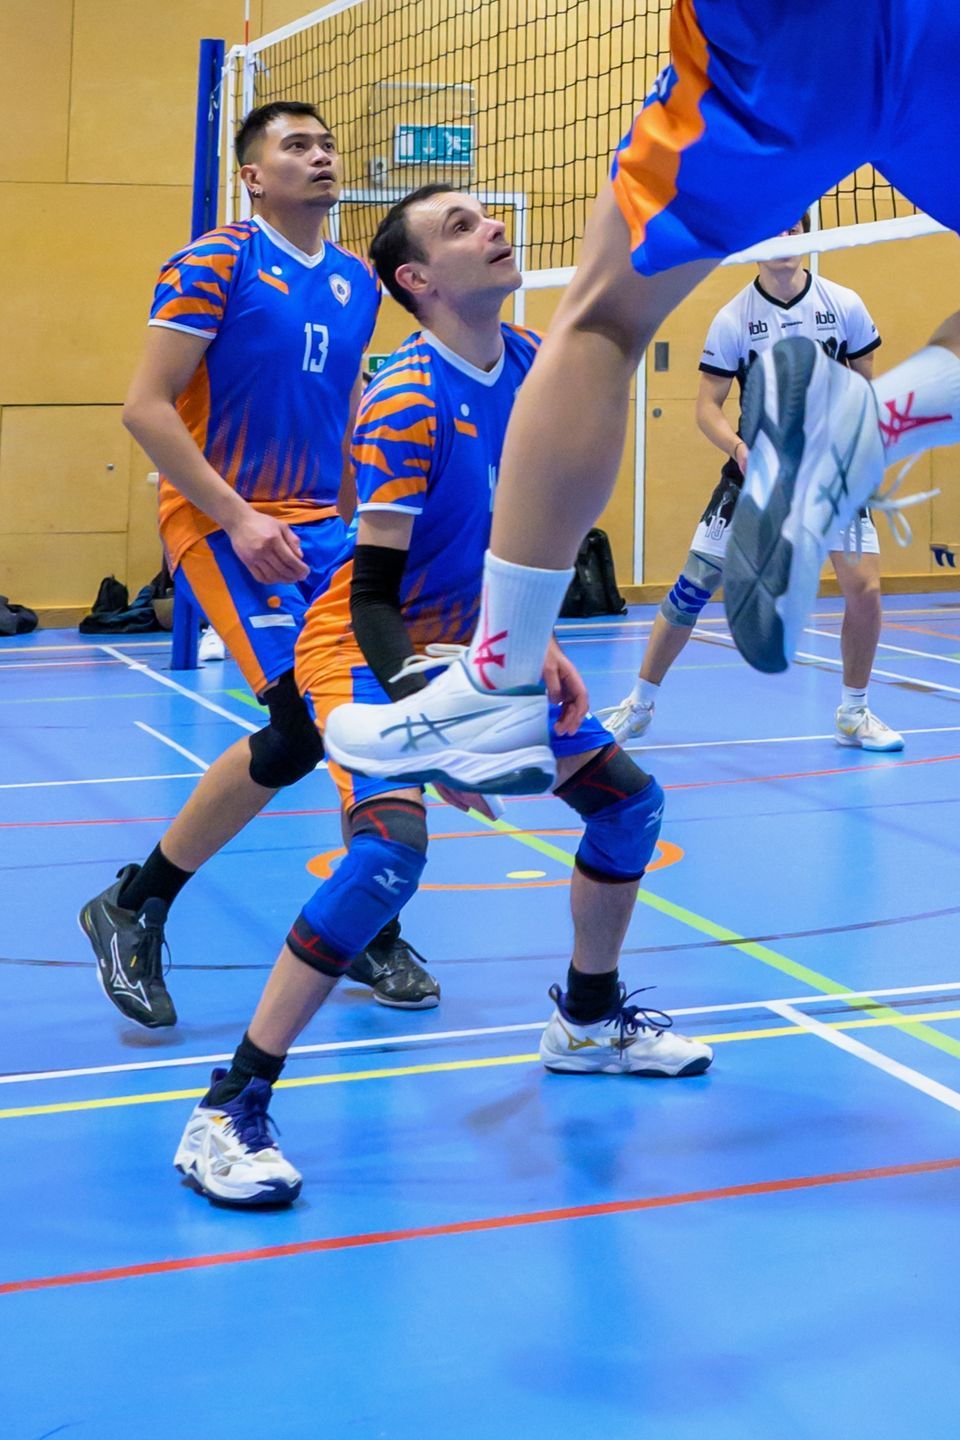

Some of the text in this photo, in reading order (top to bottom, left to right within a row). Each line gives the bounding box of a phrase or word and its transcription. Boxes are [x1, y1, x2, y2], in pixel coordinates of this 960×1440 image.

[748, 319, 768, 336] ibb
[816, 311, 836, 325] ibb
[302, 322, 330, 374] 13
[705, 515, 727, 540] 19
